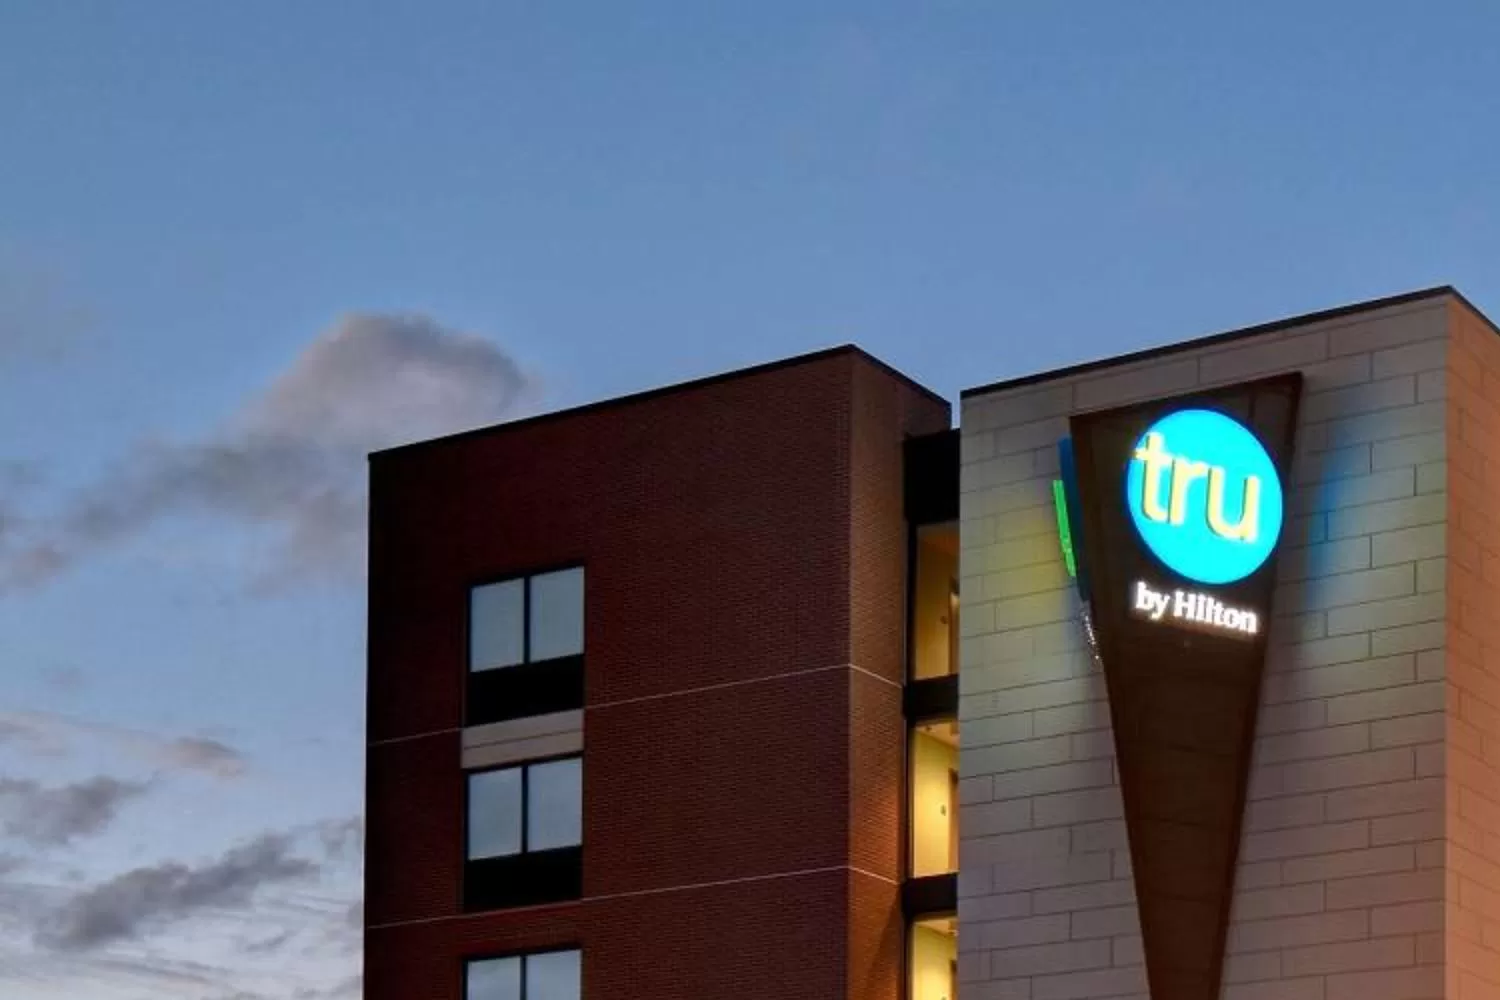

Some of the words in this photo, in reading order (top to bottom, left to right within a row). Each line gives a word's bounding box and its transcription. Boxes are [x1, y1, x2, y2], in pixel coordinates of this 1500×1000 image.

[1135, 431, 1259, 543] tru
[1135, 580, 1170, 620] by
[1173, 590, 1257, 634] Hilton
